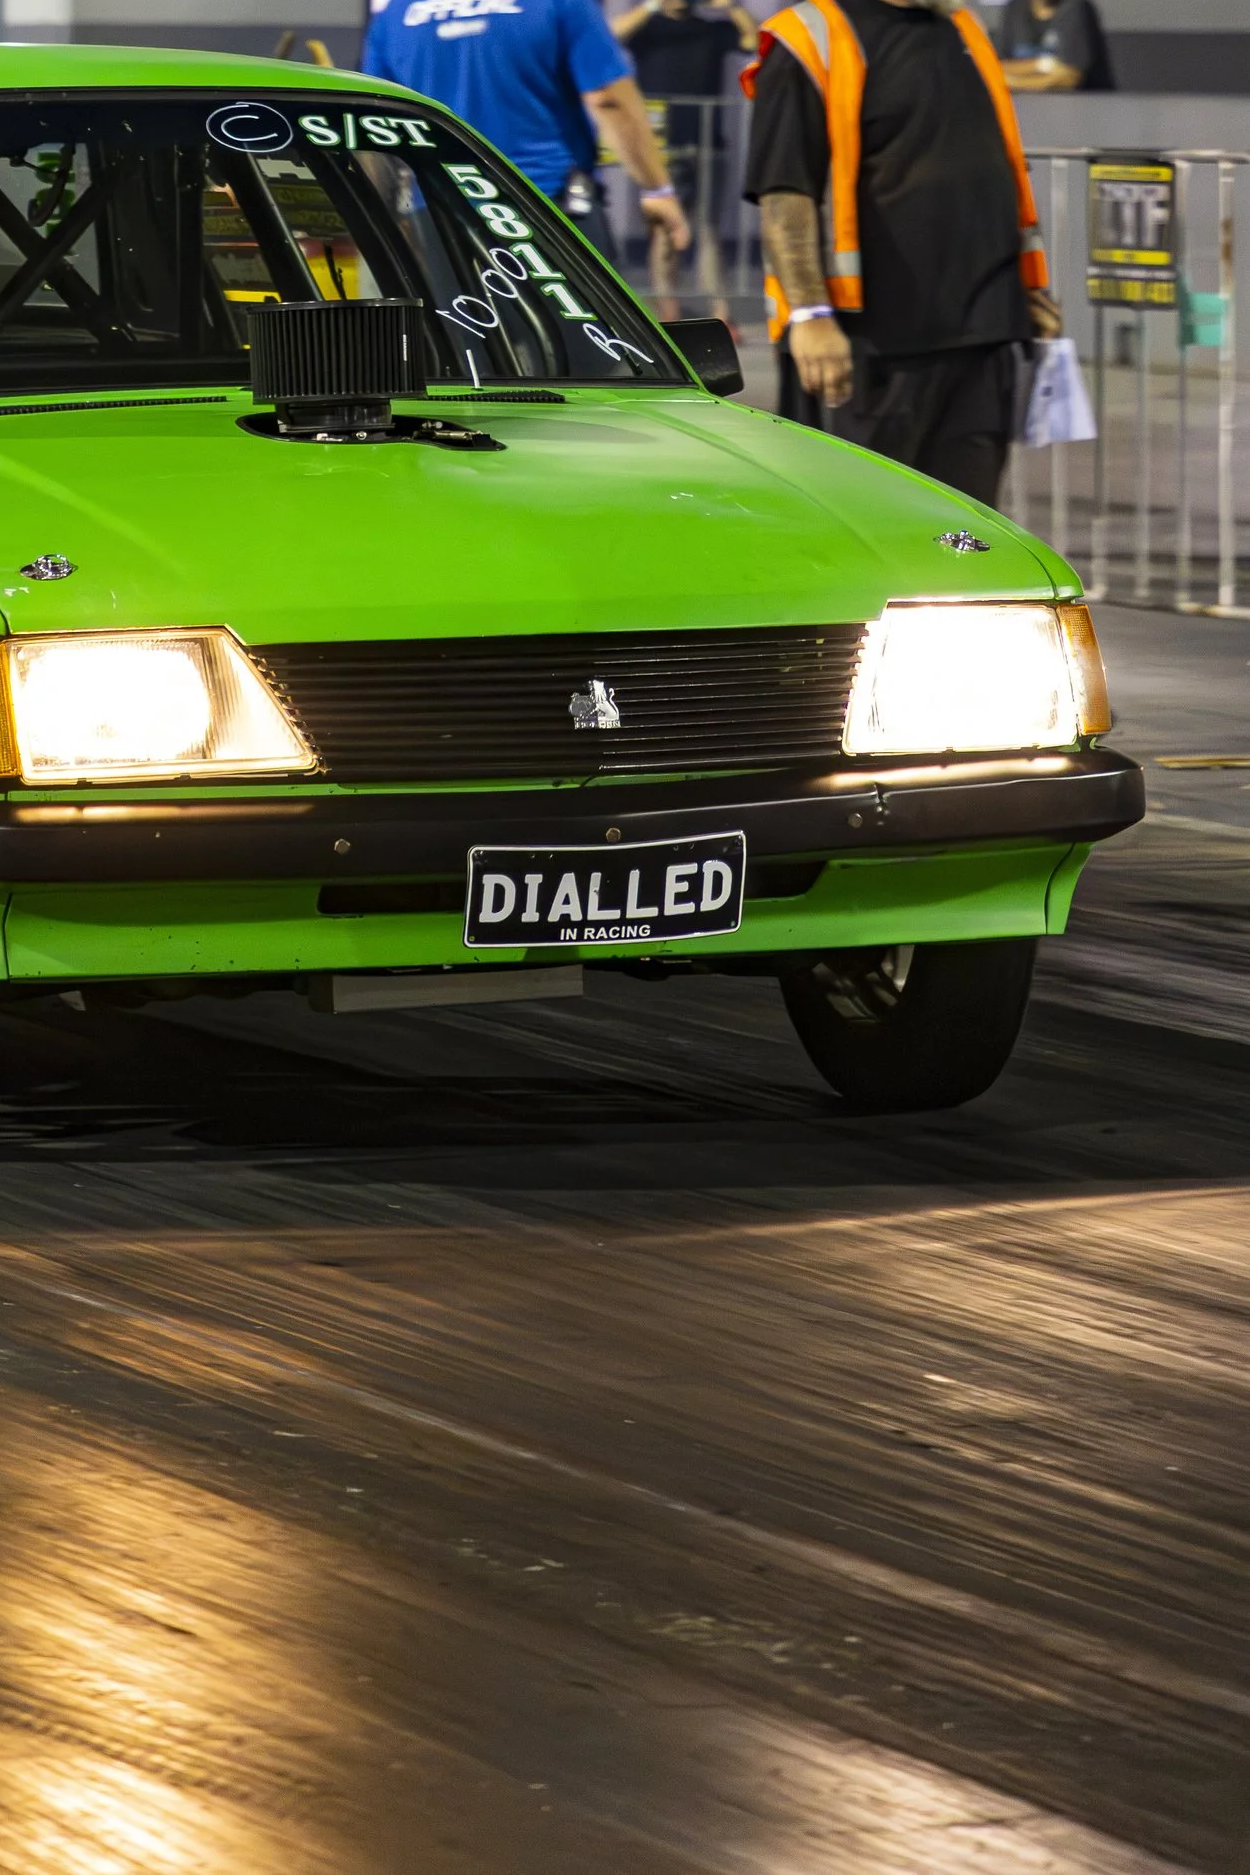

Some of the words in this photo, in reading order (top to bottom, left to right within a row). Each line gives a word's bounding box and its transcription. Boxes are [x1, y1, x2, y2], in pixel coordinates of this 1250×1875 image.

[478, 860, 733, 923] DIALLED
[560, 927, 578, 941] IN
[583, 924, 651, 940] RACING
